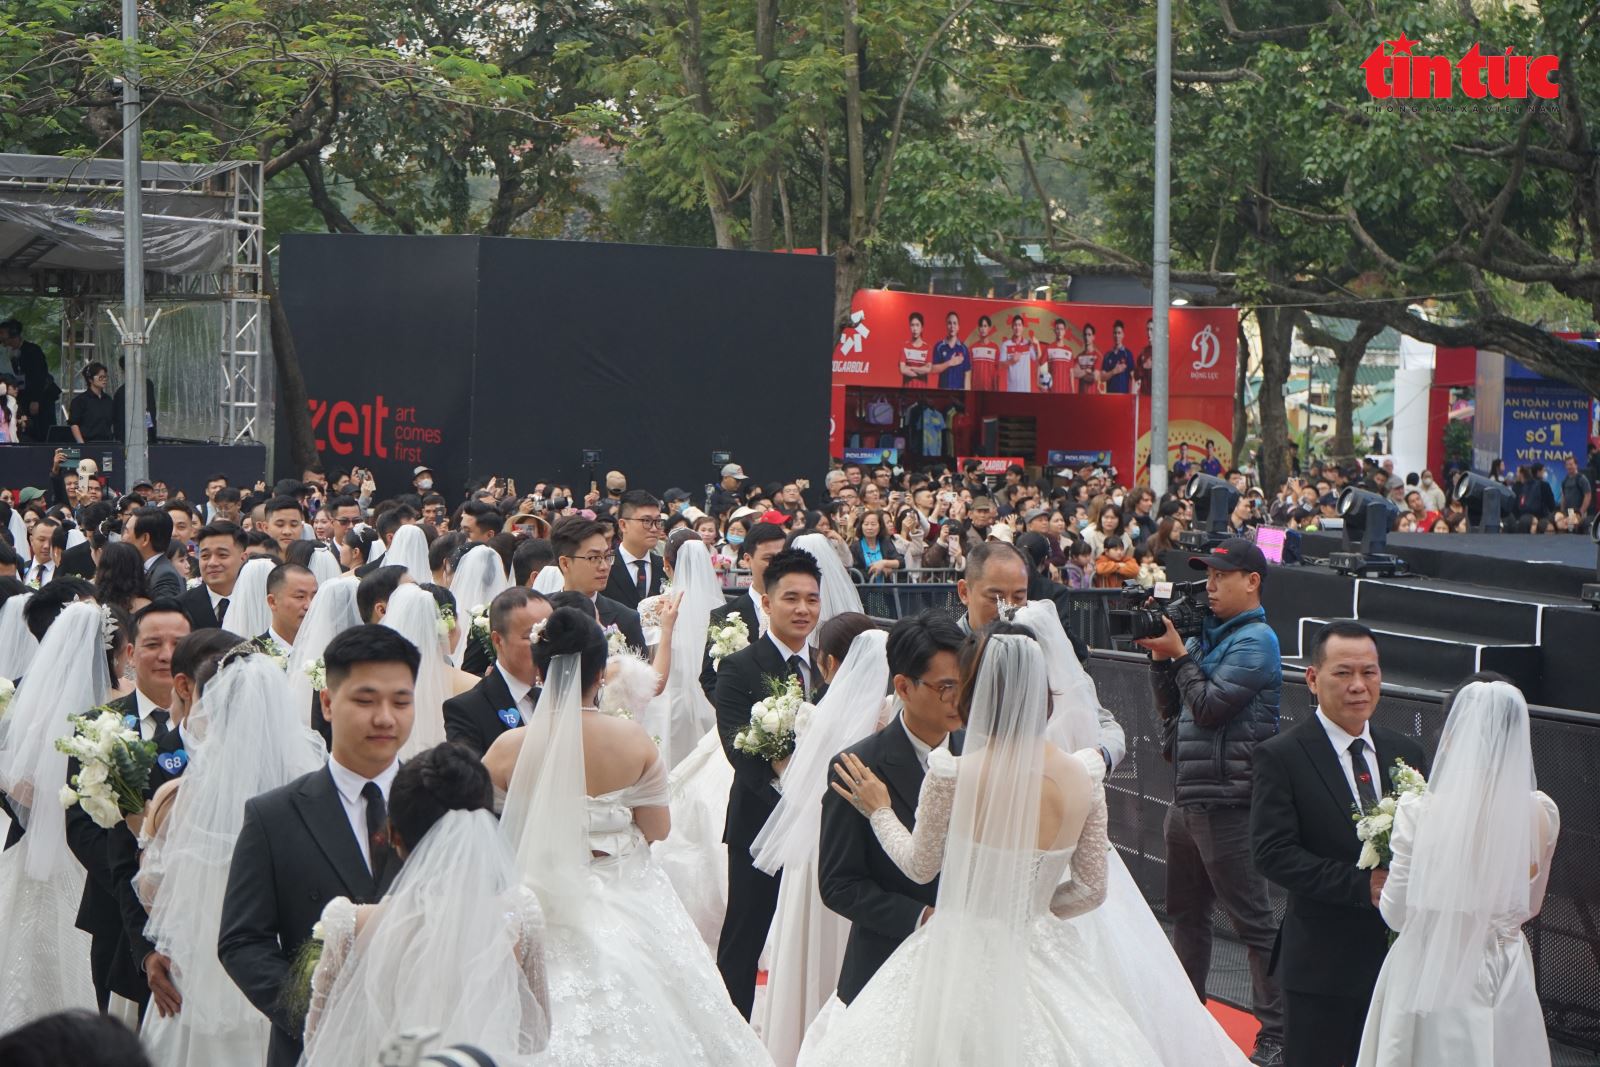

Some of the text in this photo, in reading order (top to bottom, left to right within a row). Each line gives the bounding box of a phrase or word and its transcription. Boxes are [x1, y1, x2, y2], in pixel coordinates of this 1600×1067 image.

[1504, 398, 1520, 407] AN
[1521, 397, 1549, 408] TOÀN
[1557, 400, 1571, 409] UY
[395, 407, 416, 423] art
[394, 425, 442, 444] comes
[1550, 423, 1564, 447] 1
[394, 443, 423, 463] first
[1516, 447, 1573, 462] VIỆT NAM
[164, 756, 182, 770] 68
